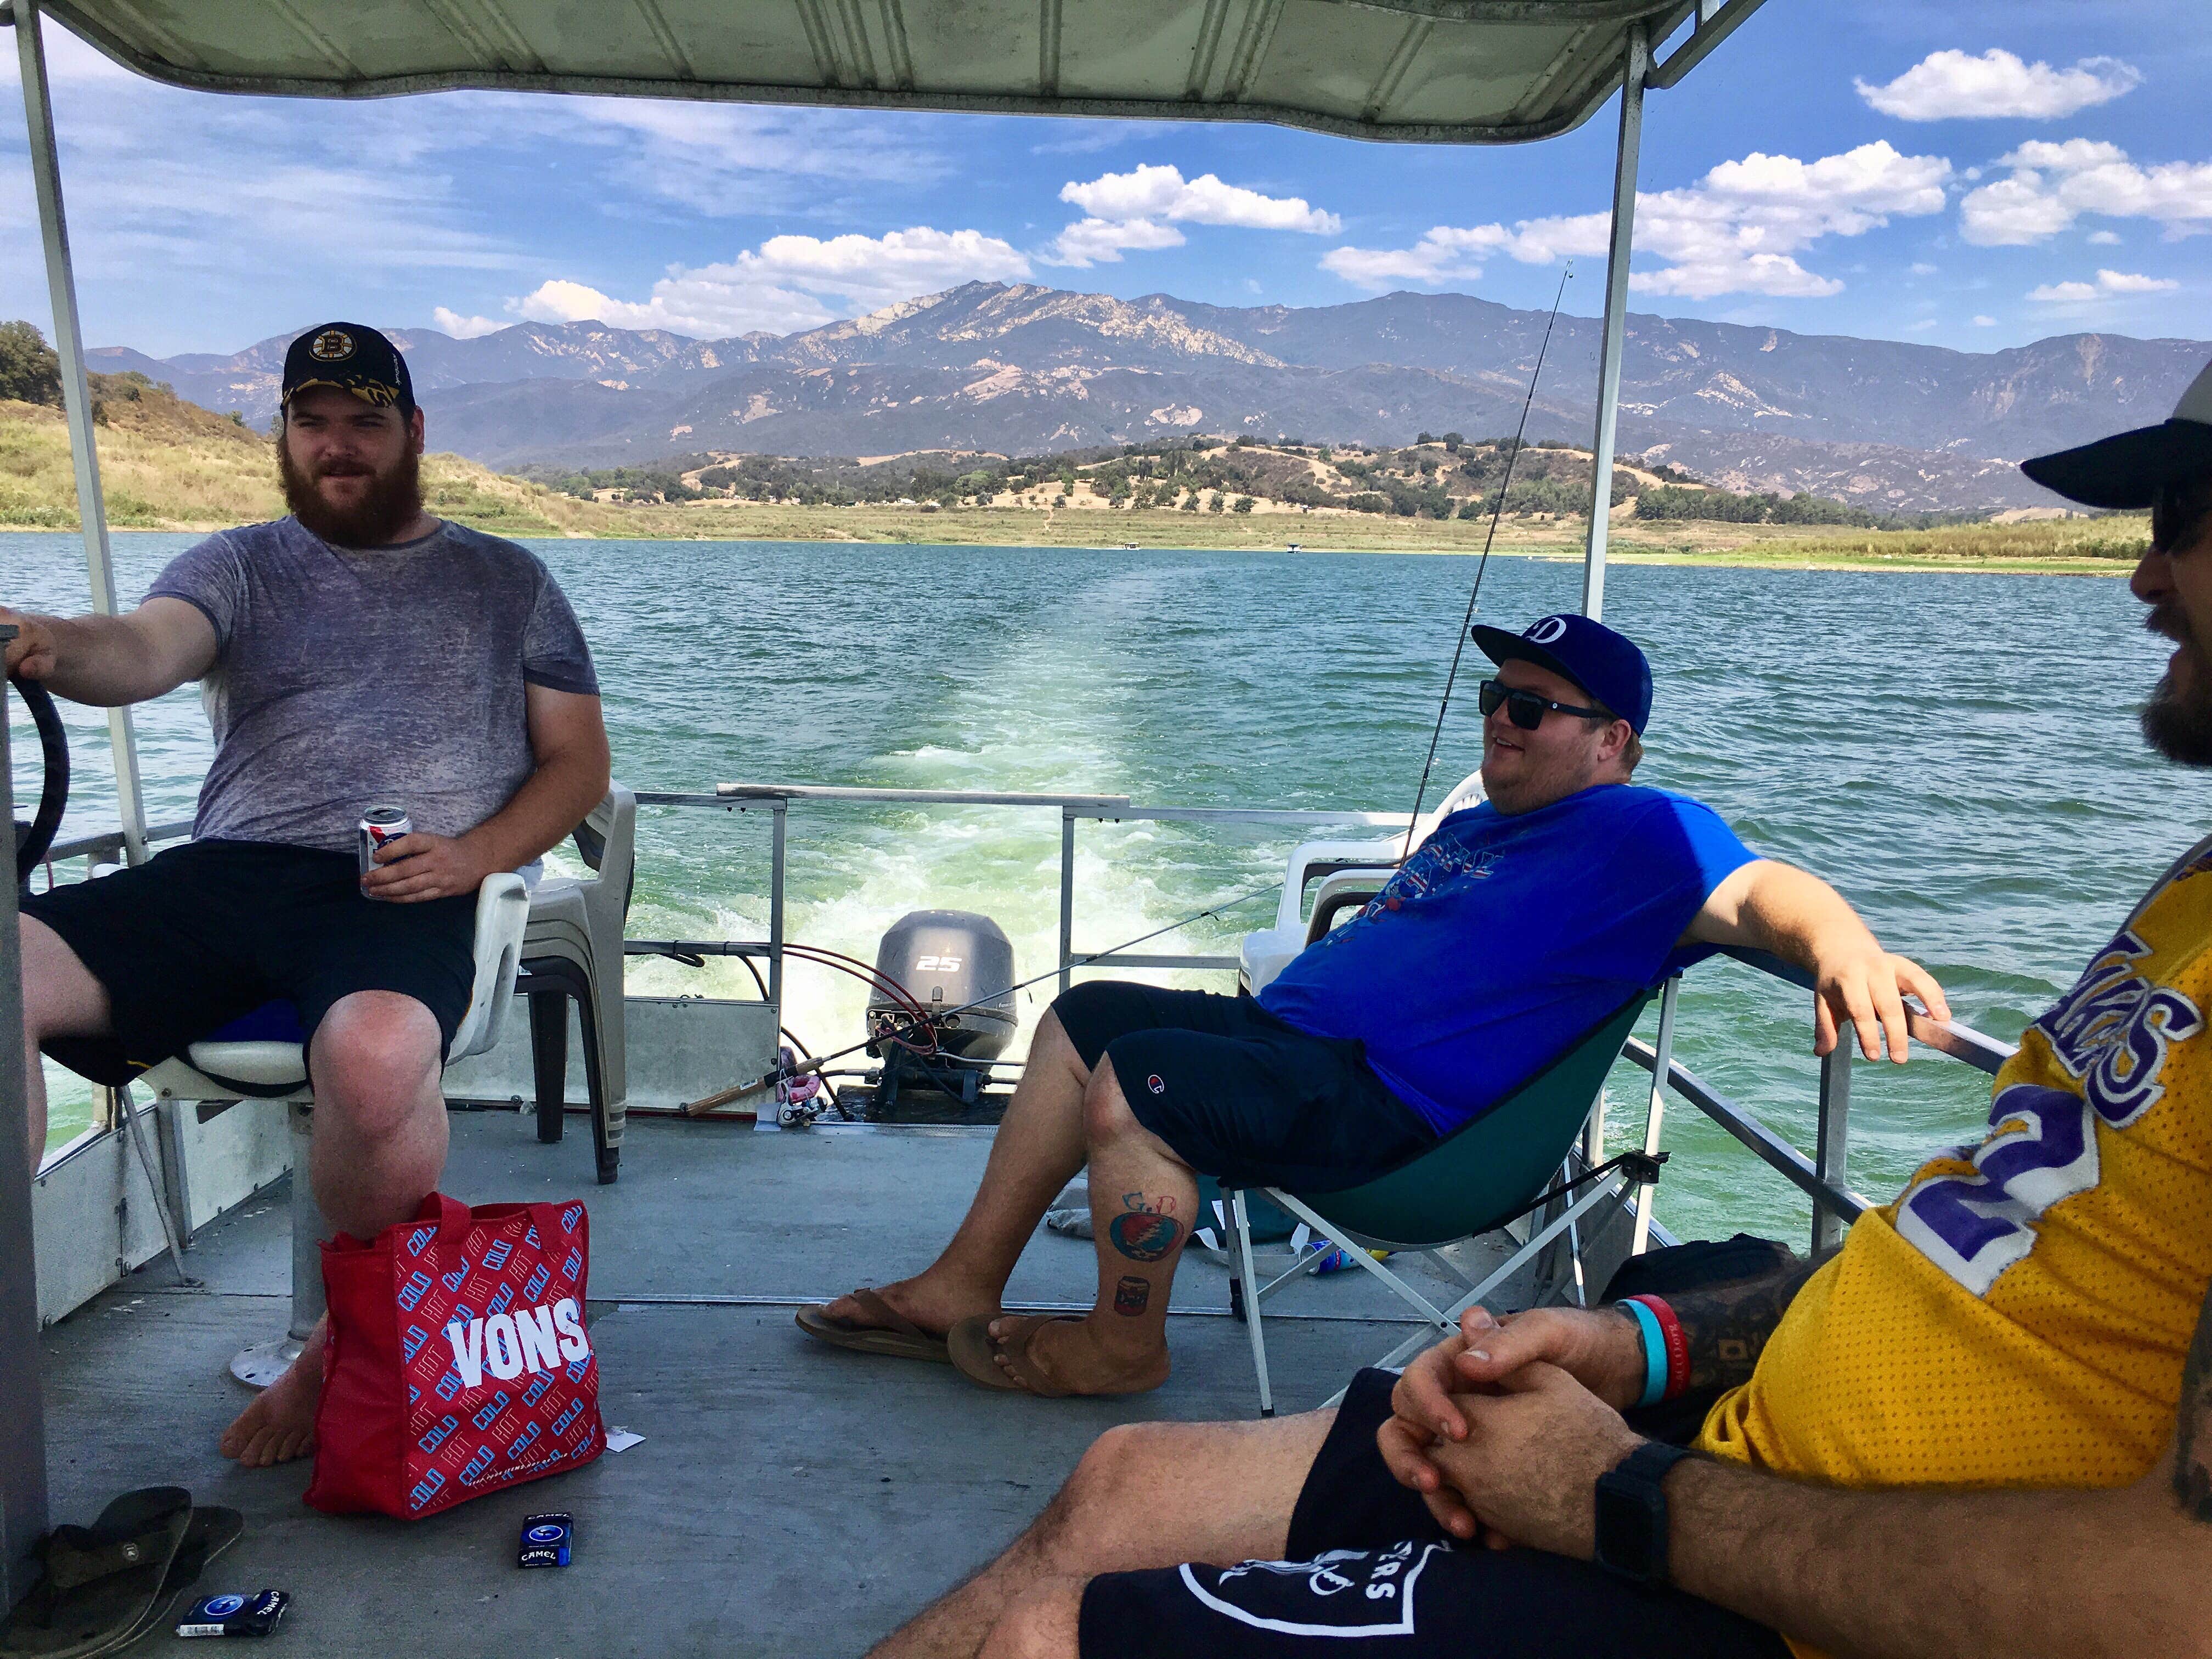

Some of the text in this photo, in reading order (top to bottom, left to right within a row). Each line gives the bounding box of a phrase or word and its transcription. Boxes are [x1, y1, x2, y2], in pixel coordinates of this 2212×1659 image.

[322, 334, 343, 354] B
[1525, 617, 1567, 644] D
[916, 956, 962, 972] 25
[482, 1239, 514, 1271] COLD
[509, 1249, 533, 1283] HOT
[397, 1271, 433, 1312] COLD
[464, 1273, 493, 1303] HOT
[523, 1263, 551, 1302] COLD
[421, 1289, 448, 1324] HOT
[447, 1298, 589, 1389] VONS
[414, 1344, 444, 1381] HOT
[522, 1368, 555, 1408] COLD
[540, 1385, 567, 1420] HOT
[472, 1390, 510, 1431] COLD
[492, 1408, 521, 1444] HOT
[551, 1397, 584, 1436] COLD
[418, 1414, 459, 1454] COLD
[507, 1420, 542, 1460] COLD
[565, 1414, 589, 1447] HOT
[441, 1431, 472, 1468] HOT
[459, 1444, 495, 1486] COLD
[521, 1550, 556, 1561] CAMEL
[256, 1591, 280, 1615] CAMEL
